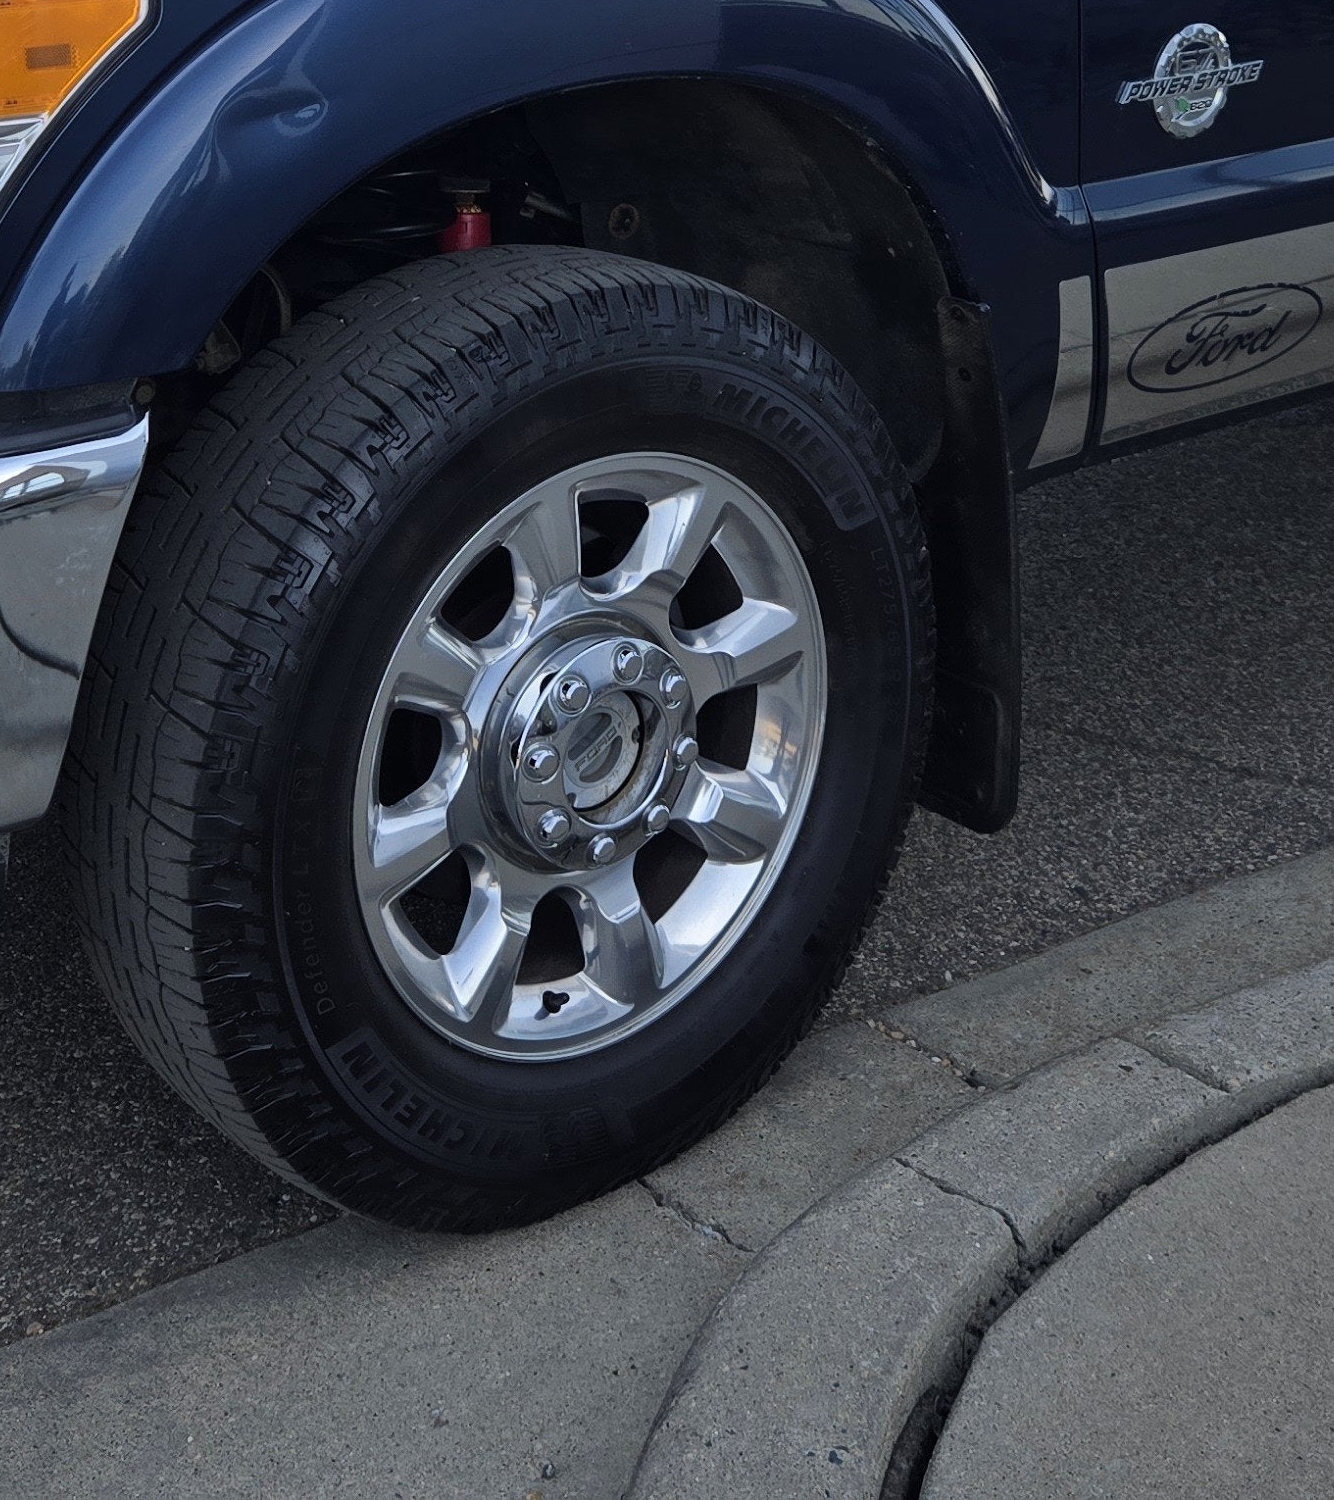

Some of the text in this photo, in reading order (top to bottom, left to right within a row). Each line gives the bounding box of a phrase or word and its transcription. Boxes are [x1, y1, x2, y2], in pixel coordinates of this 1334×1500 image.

[1126, 61, 1262, 102] POWER STROKE
[1164, 303, 1293, 376] Ford
[713, 381, 869, 520] MICHELIN
[574, 725, 618, 772] FORD
[293, 889, 337, 1016] Defender
[341, 1041, 526, 1161] MICHELIN
